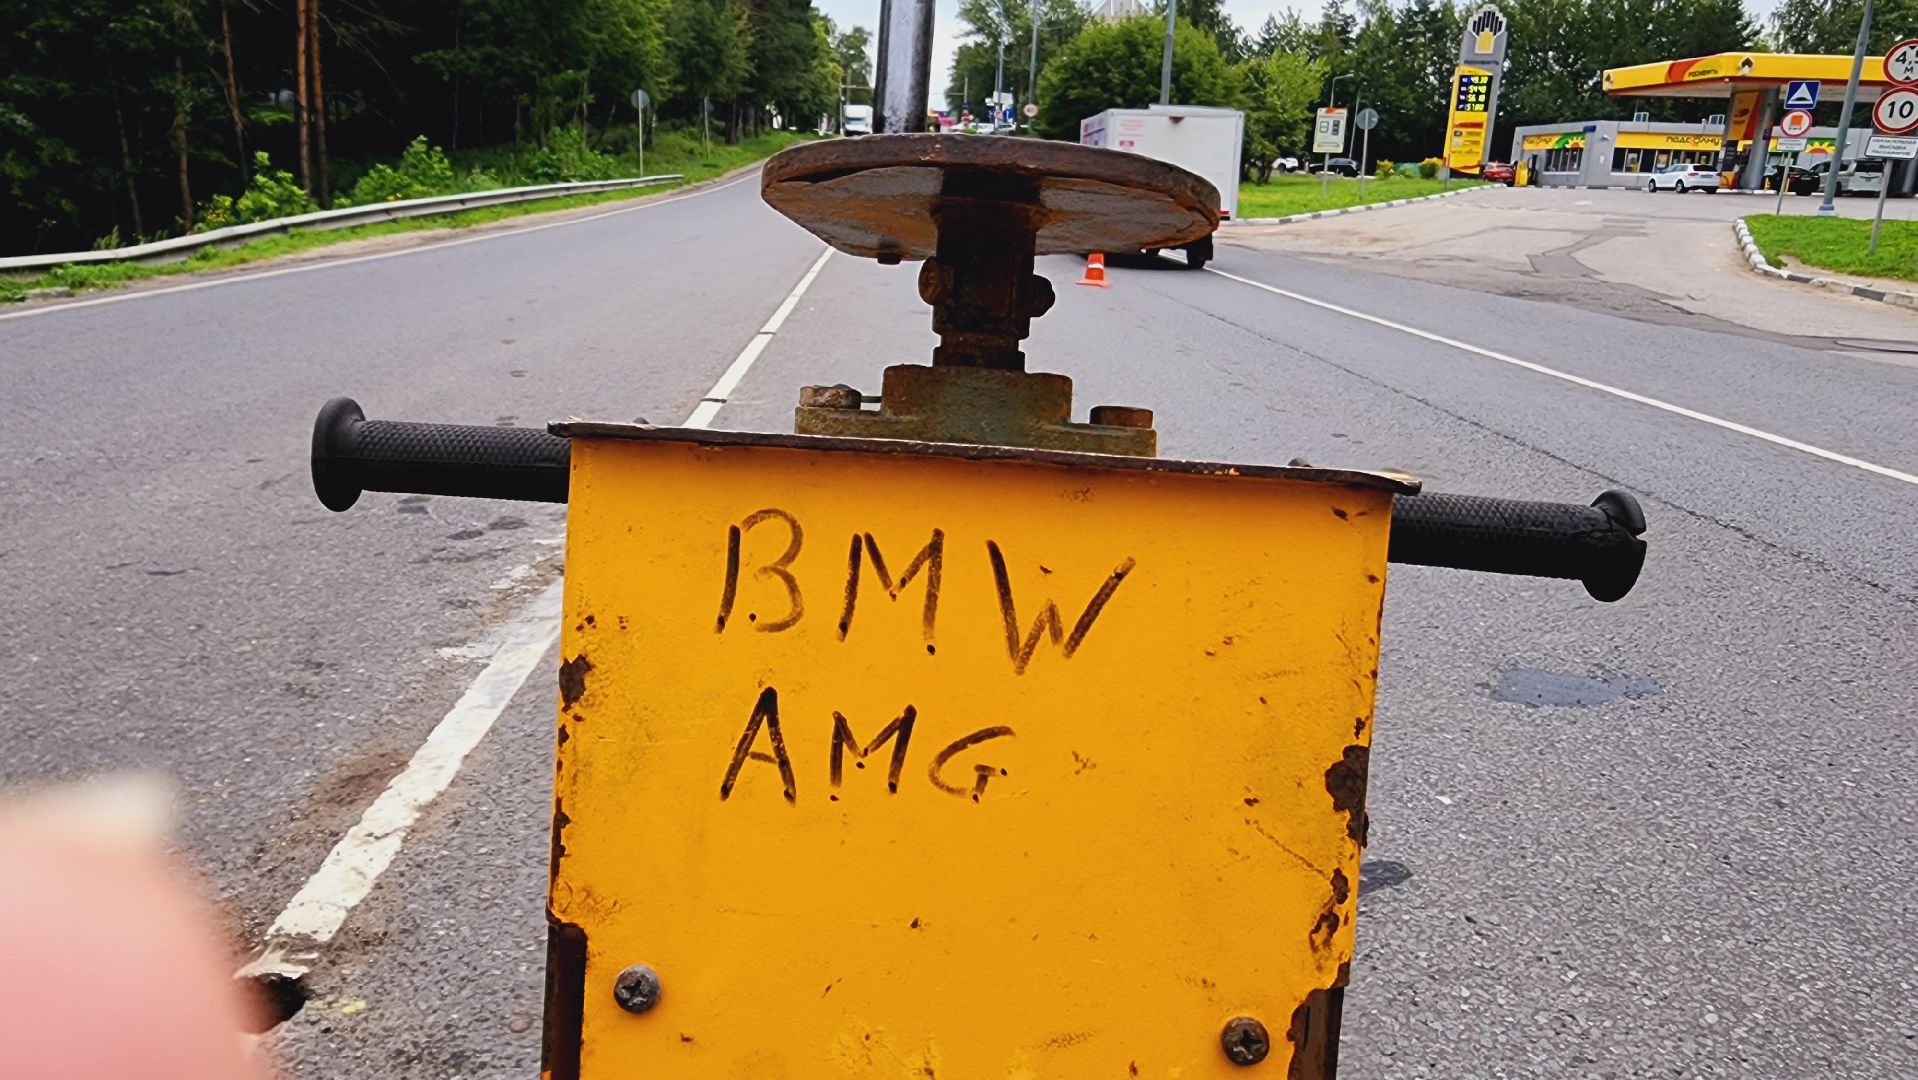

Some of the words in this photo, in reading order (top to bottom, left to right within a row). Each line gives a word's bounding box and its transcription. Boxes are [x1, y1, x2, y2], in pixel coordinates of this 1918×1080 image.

[1904, 66, 1914, 74] М
[1887, 100, 1914, 119] 10
[1666, 135, 1720, 147] ПОДСОЛНУ
[714, 507, 1137, 676] BMW
[719, 687, 1017, 805] AMG
